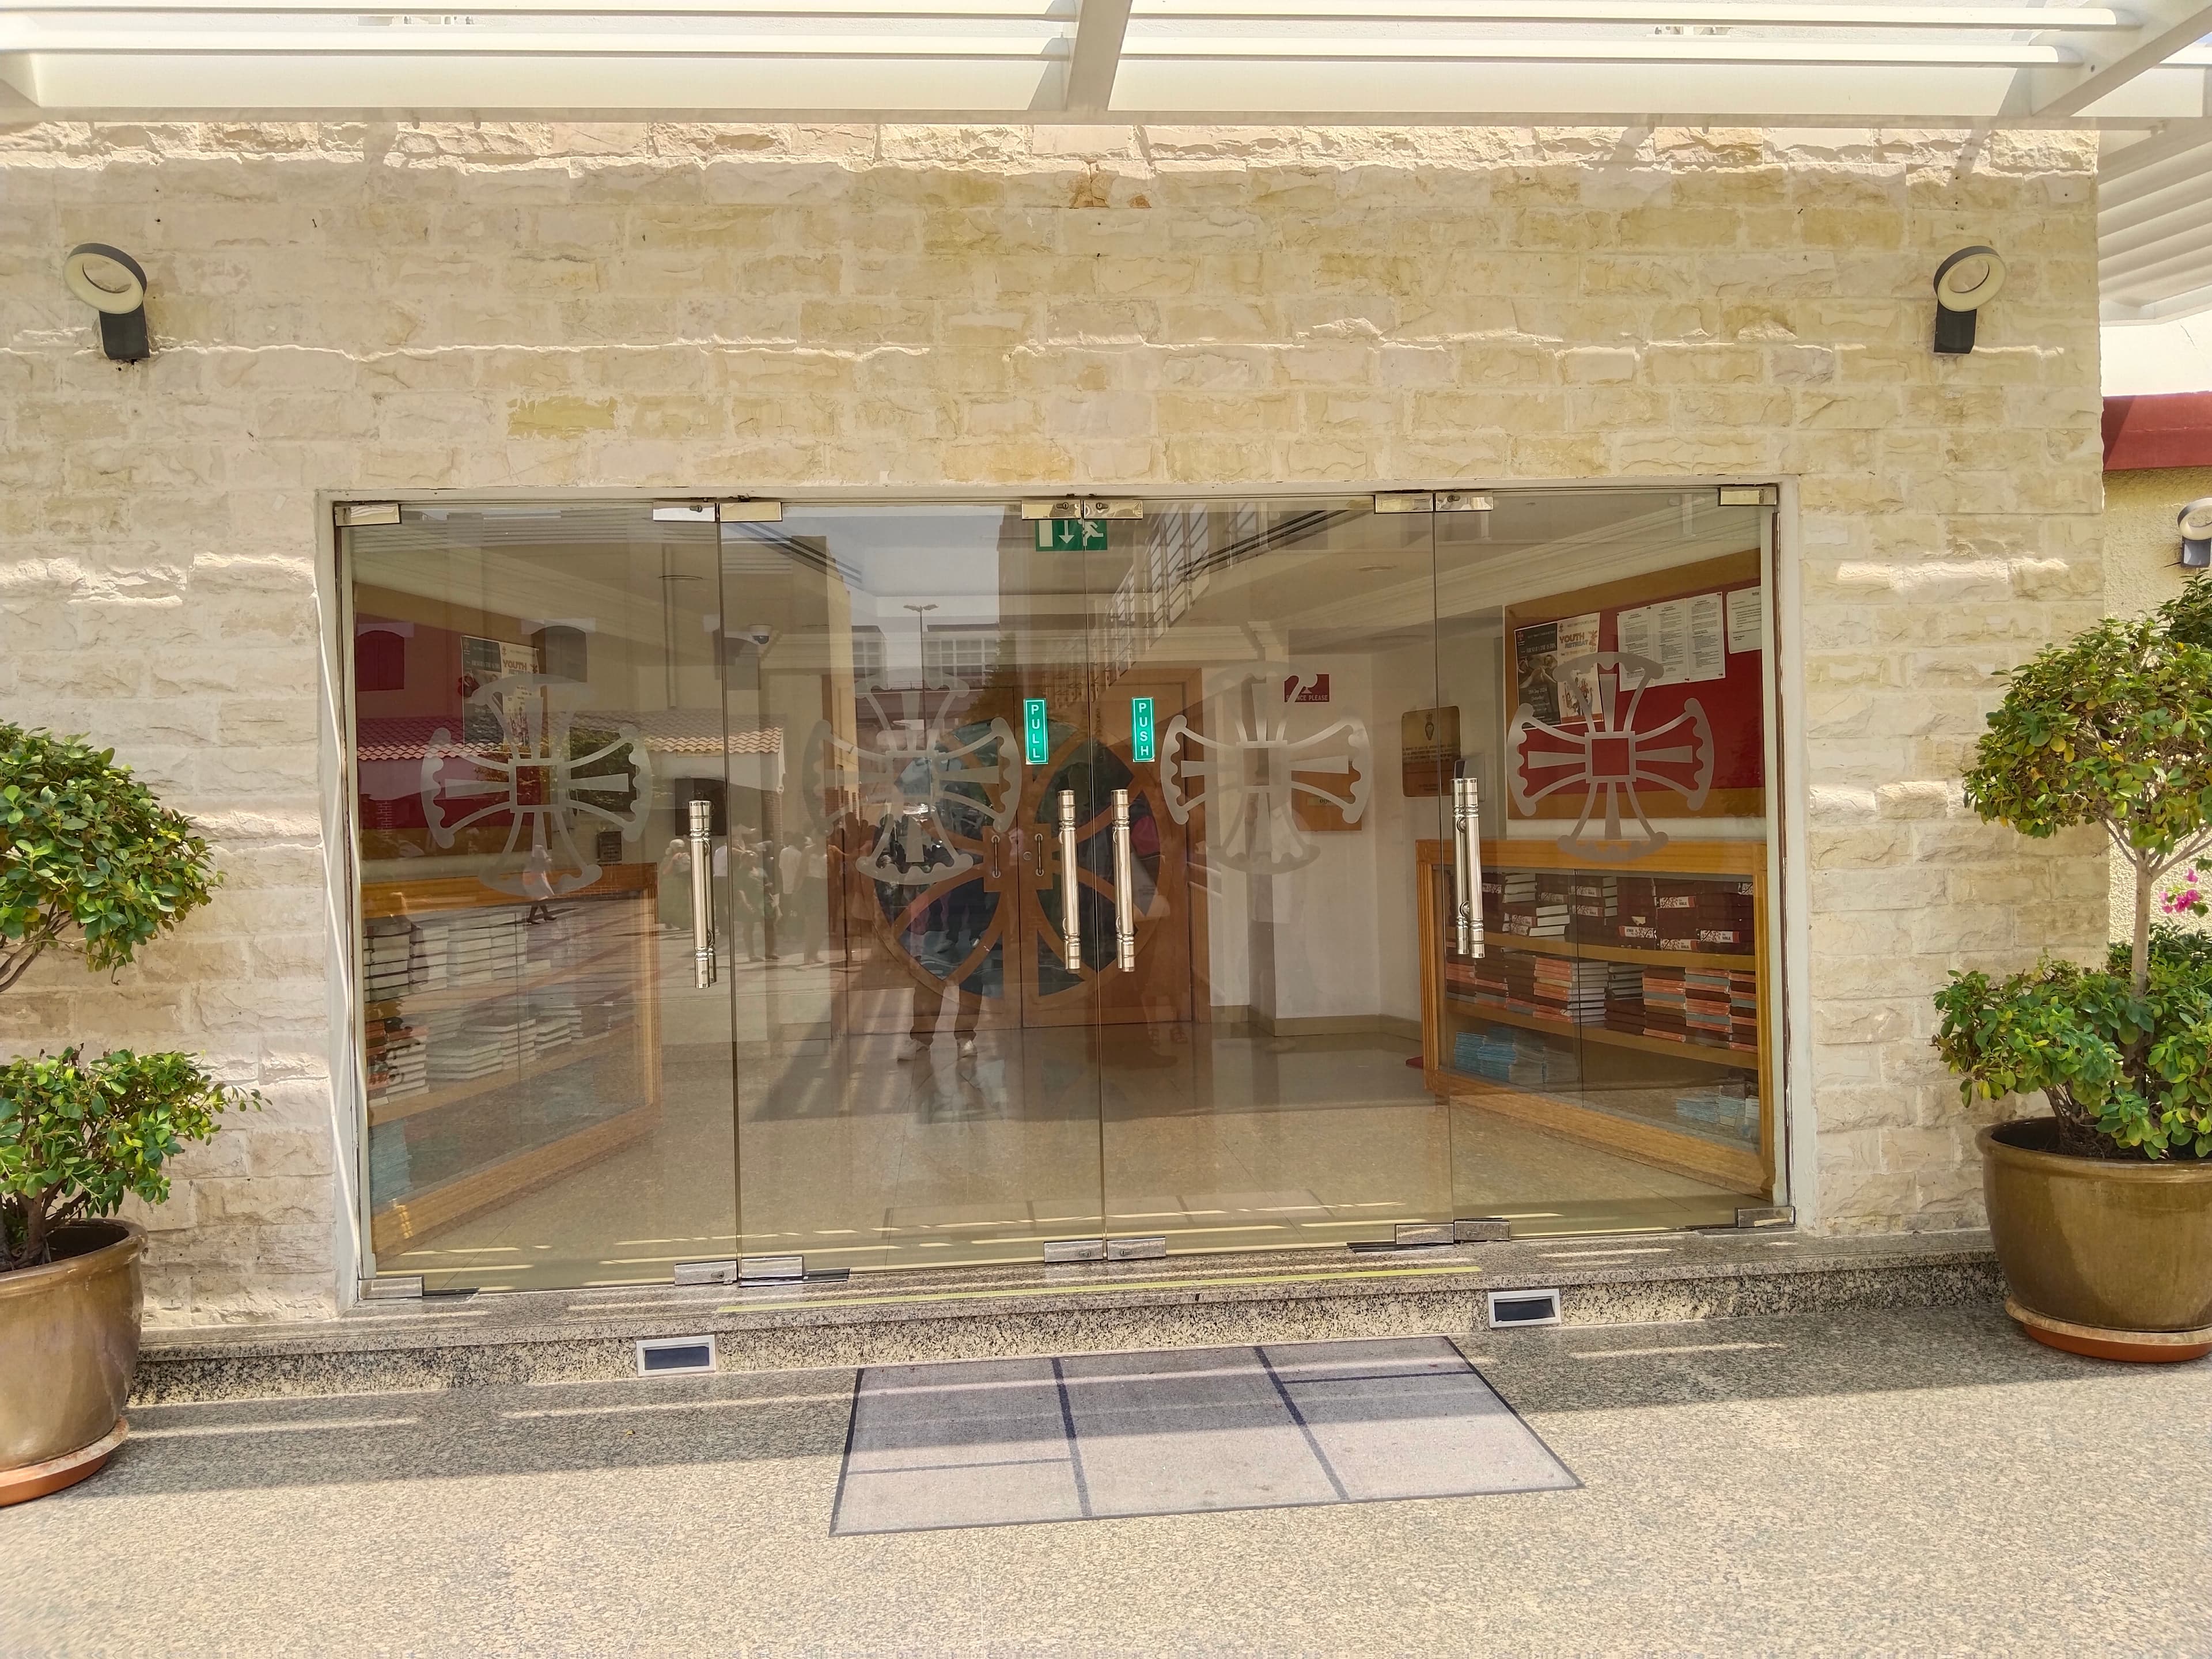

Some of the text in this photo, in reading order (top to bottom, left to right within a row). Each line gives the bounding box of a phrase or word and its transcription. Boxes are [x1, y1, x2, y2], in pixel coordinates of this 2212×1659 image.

[1559, 632, 1585, 643] YOUTH
[502, 659, 527, 671] YOUTH
[1031, 704, 1040, 758] PULL
[1139, 703, 1149, 756] PUSH
